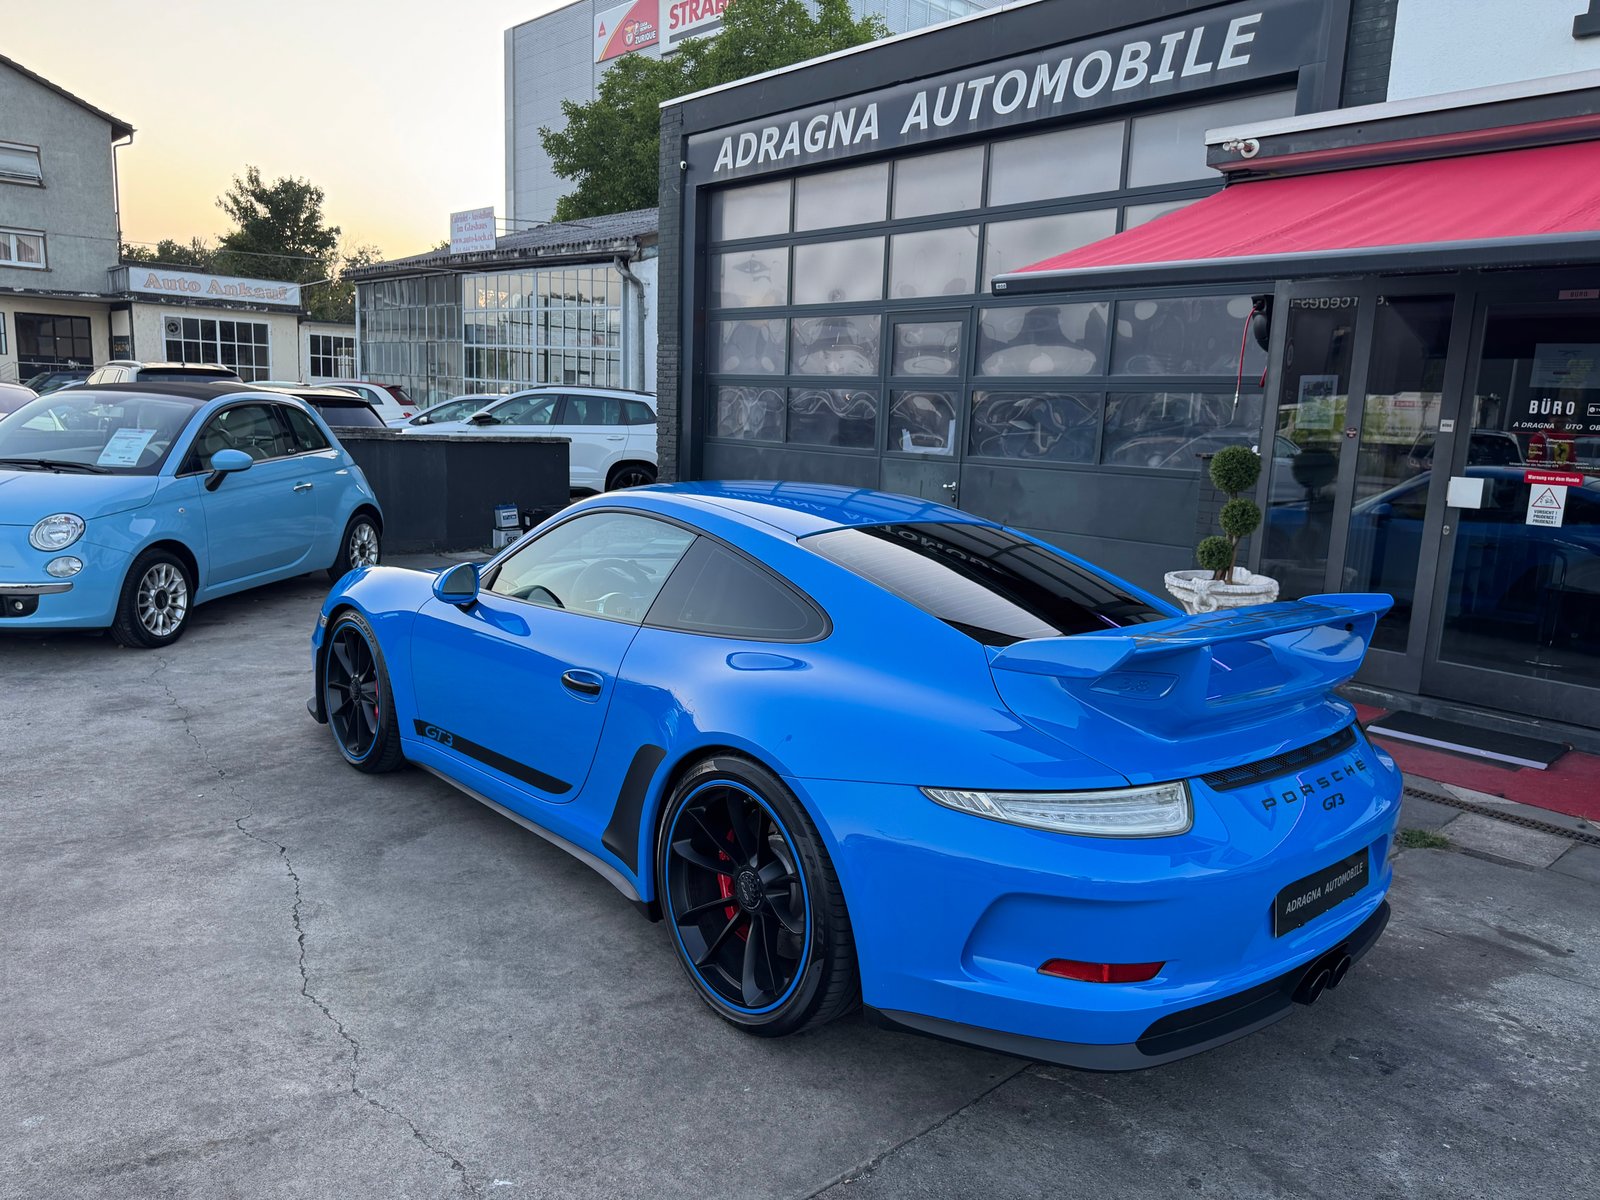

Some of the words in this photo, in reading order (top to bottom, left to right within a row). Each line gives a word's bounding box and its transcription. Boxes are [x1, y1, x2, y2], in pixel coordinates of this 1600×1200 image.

[635, 30, 656, 44] ZURIQUE
[714, 104, 879, 172] ADRAGNA
[901, 13, 1263, 134] AUTOMOBILE
[457, 224, 463, 232] im
[465, 222, 488, 232] Glashaus
[144, 273, 200, 293] Auto
[207, 279, 287, 300] Ankauf
[1529, 398, 1575, 415] BÜRO
[425, 725, 453, 747] GT3
[1262, 760, 1366, 812] PORSCHE
[1322, 792, 1345, 811] GT3
[1286, 888, 1322, 915] ADRAGNA
[1325, 862, 1364, 893] AUTOMOBILE
